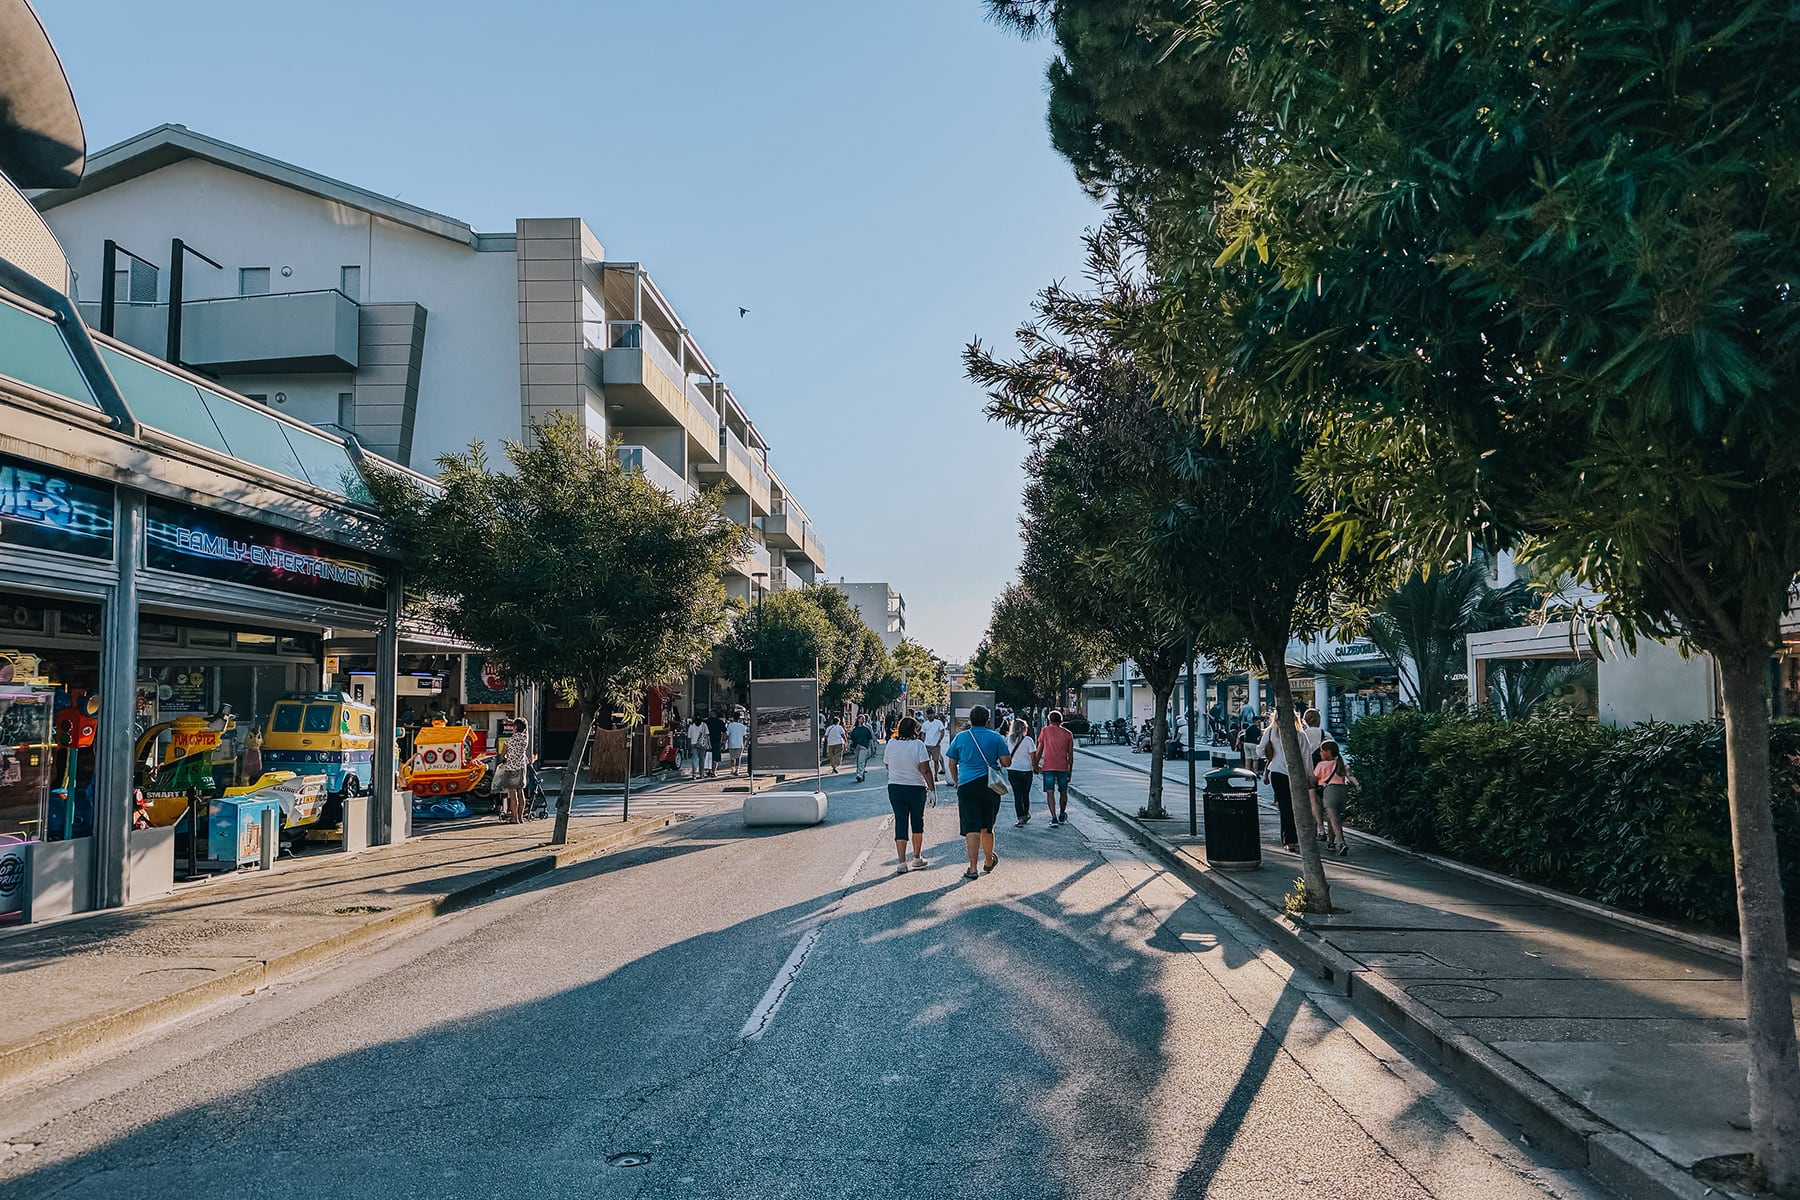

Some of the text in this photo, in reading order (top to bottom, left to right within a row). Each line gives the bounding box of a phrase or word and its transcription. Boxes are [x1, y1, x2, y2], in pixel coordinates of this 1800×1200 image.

[176, 527, 374, 588] FAMILY ENTERTAINMENT
[189, 733, 216, 746] COPTER
[146, 790, 179, 799] SMART
